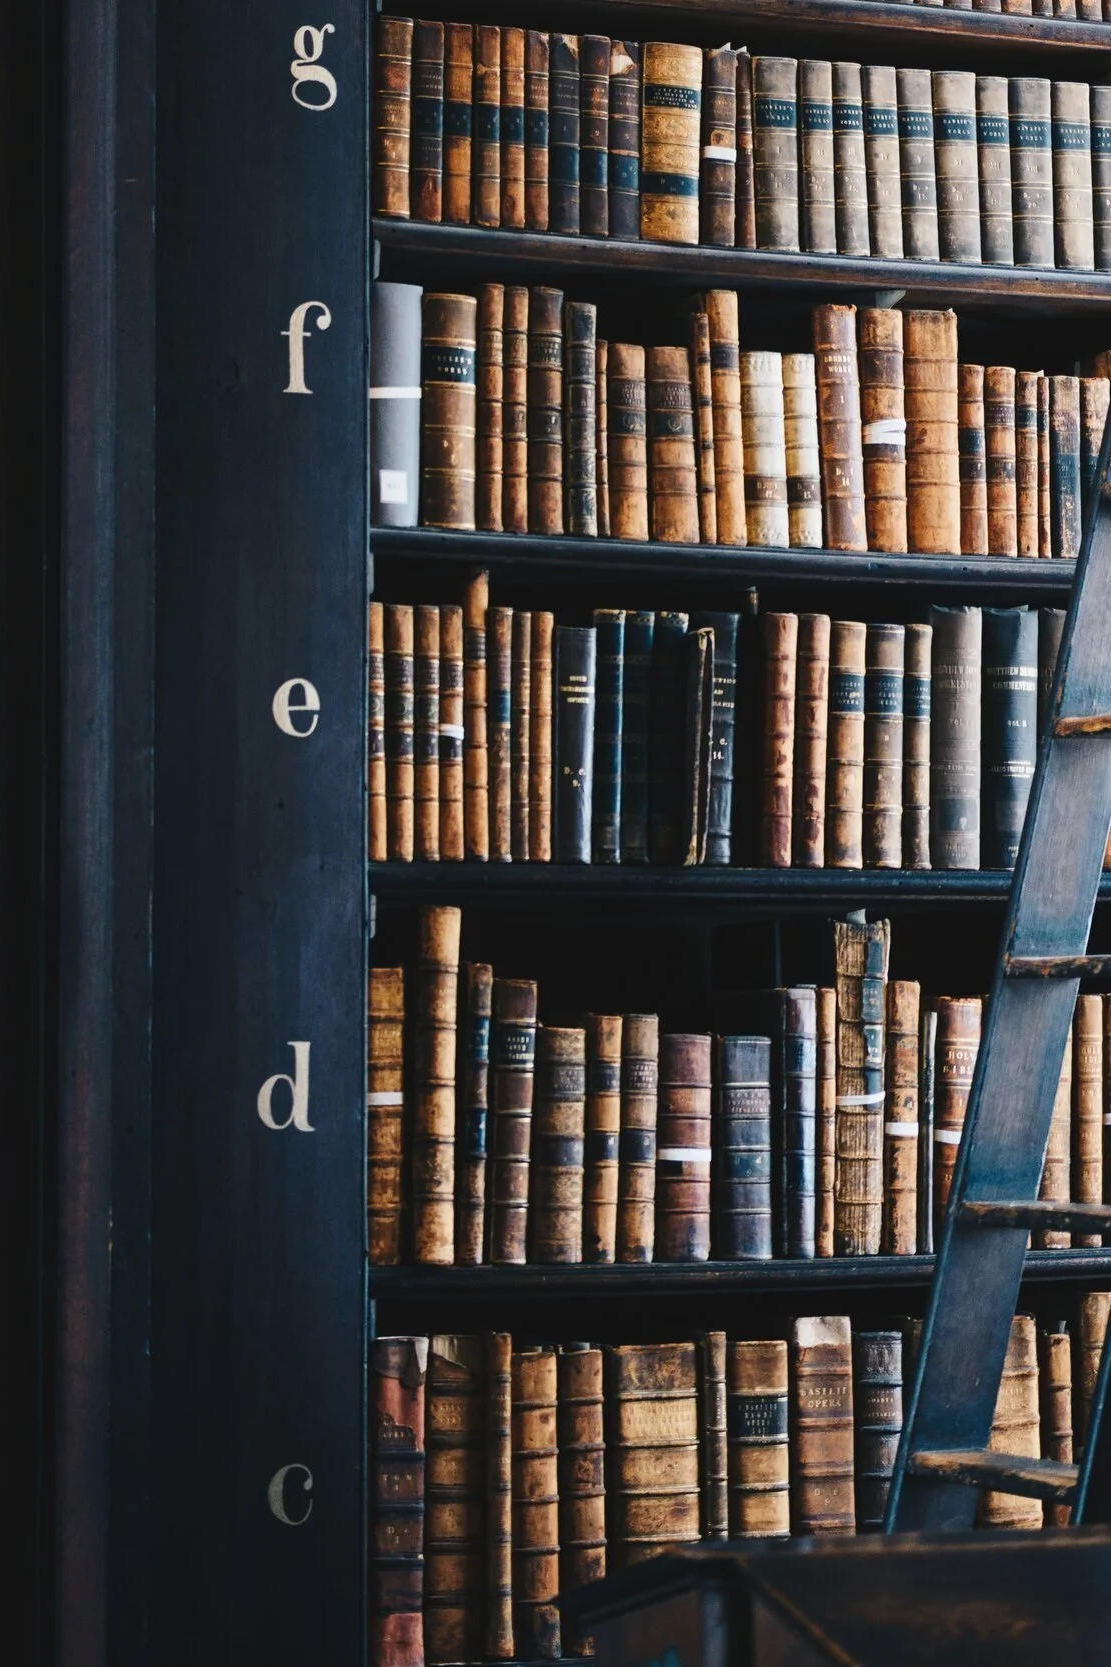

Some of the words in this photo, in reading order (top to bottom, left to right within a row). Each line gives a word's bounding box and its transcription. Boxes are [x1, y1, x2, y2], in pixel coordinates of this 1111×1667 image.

[290, 22, 338, 112] g
[280, 300, 332, 395] f
[271, 677, 321, 738] e
[257, 1040, 316, 1133] d
[943, 1065, 973, 1075] BIBL
[808, 1400, 842, 1409] OPERA
[268, 1463, 313, 1526] c
